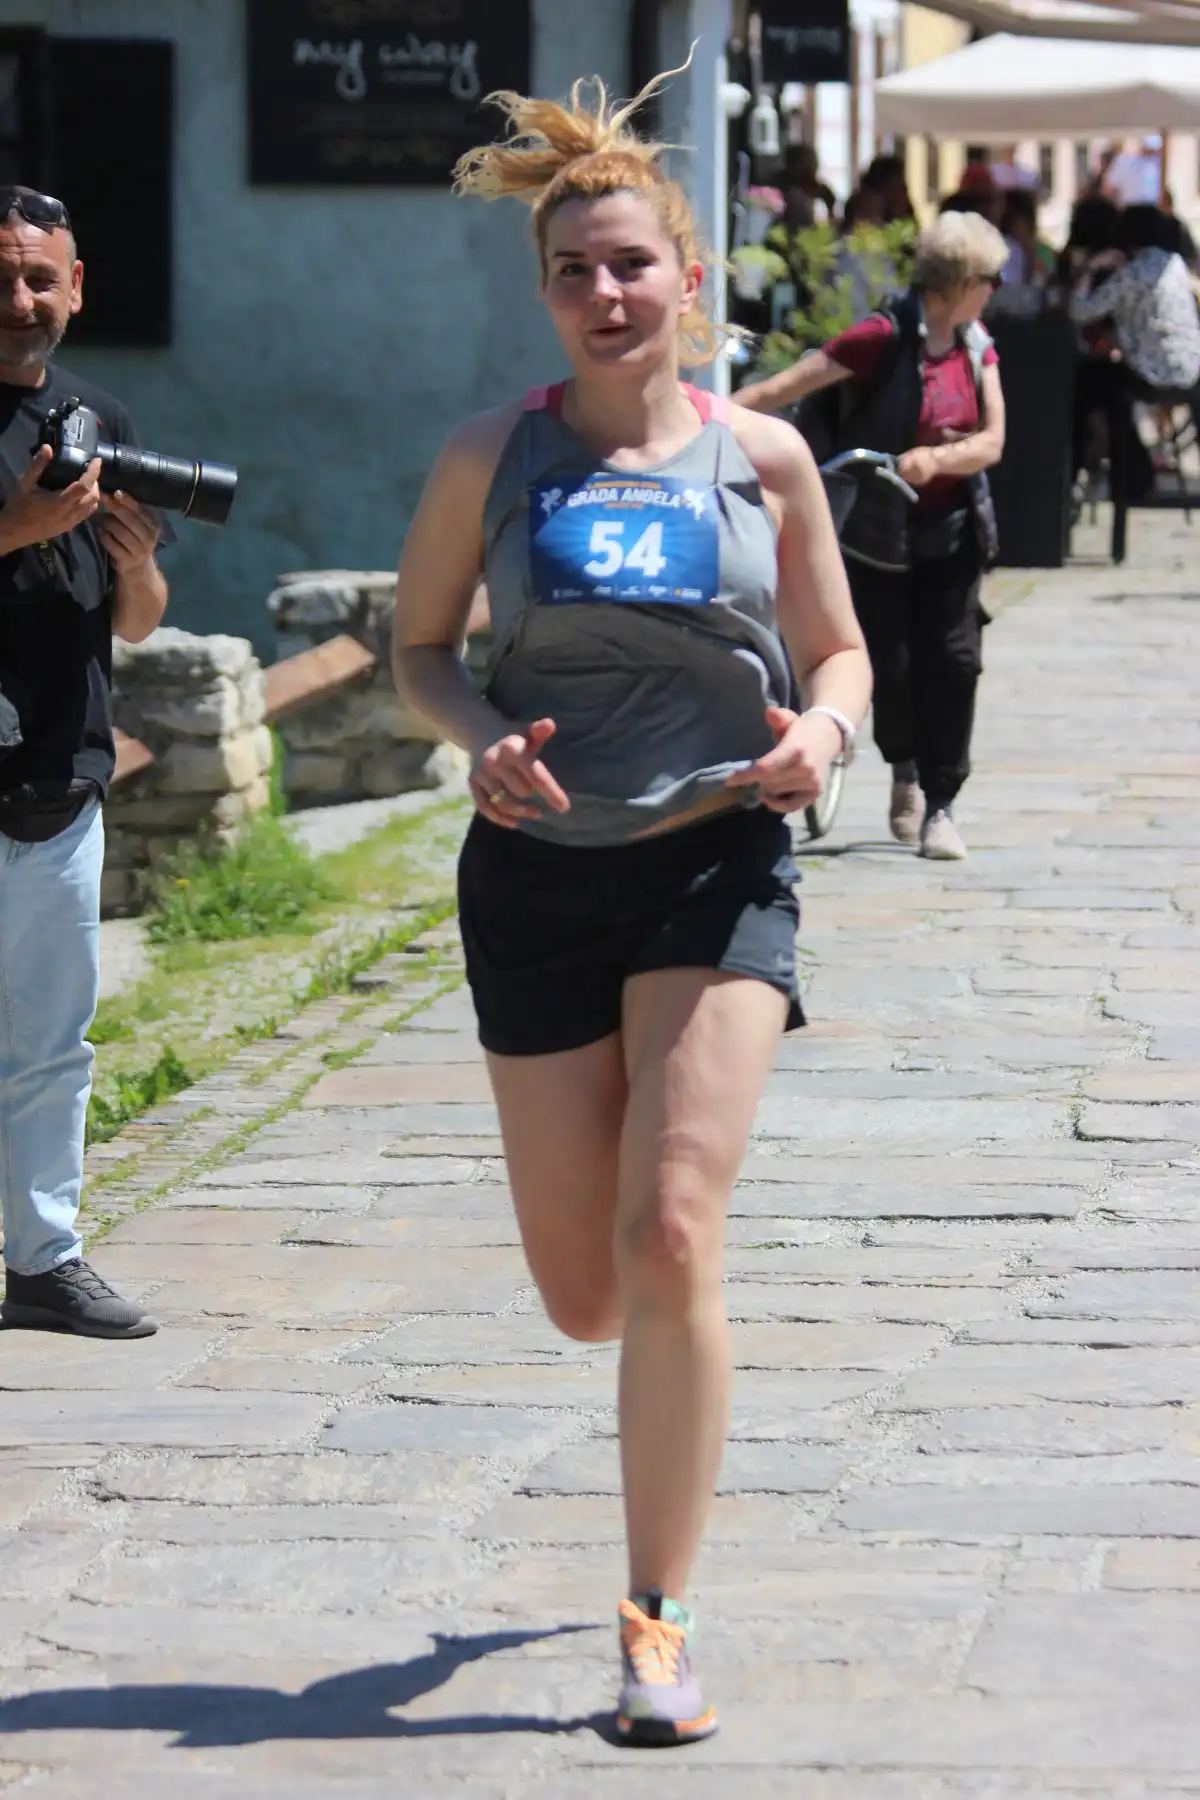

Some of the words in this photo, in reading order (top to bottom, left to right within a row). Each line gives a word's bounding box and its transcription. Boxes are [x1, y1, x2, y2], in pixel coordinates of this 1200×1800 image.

[293, 38, 366, 100] my
[378, 32, 480, 98] way
[567, 488, 618, 508] GRADA
[584, 521, 668, 577] 54
